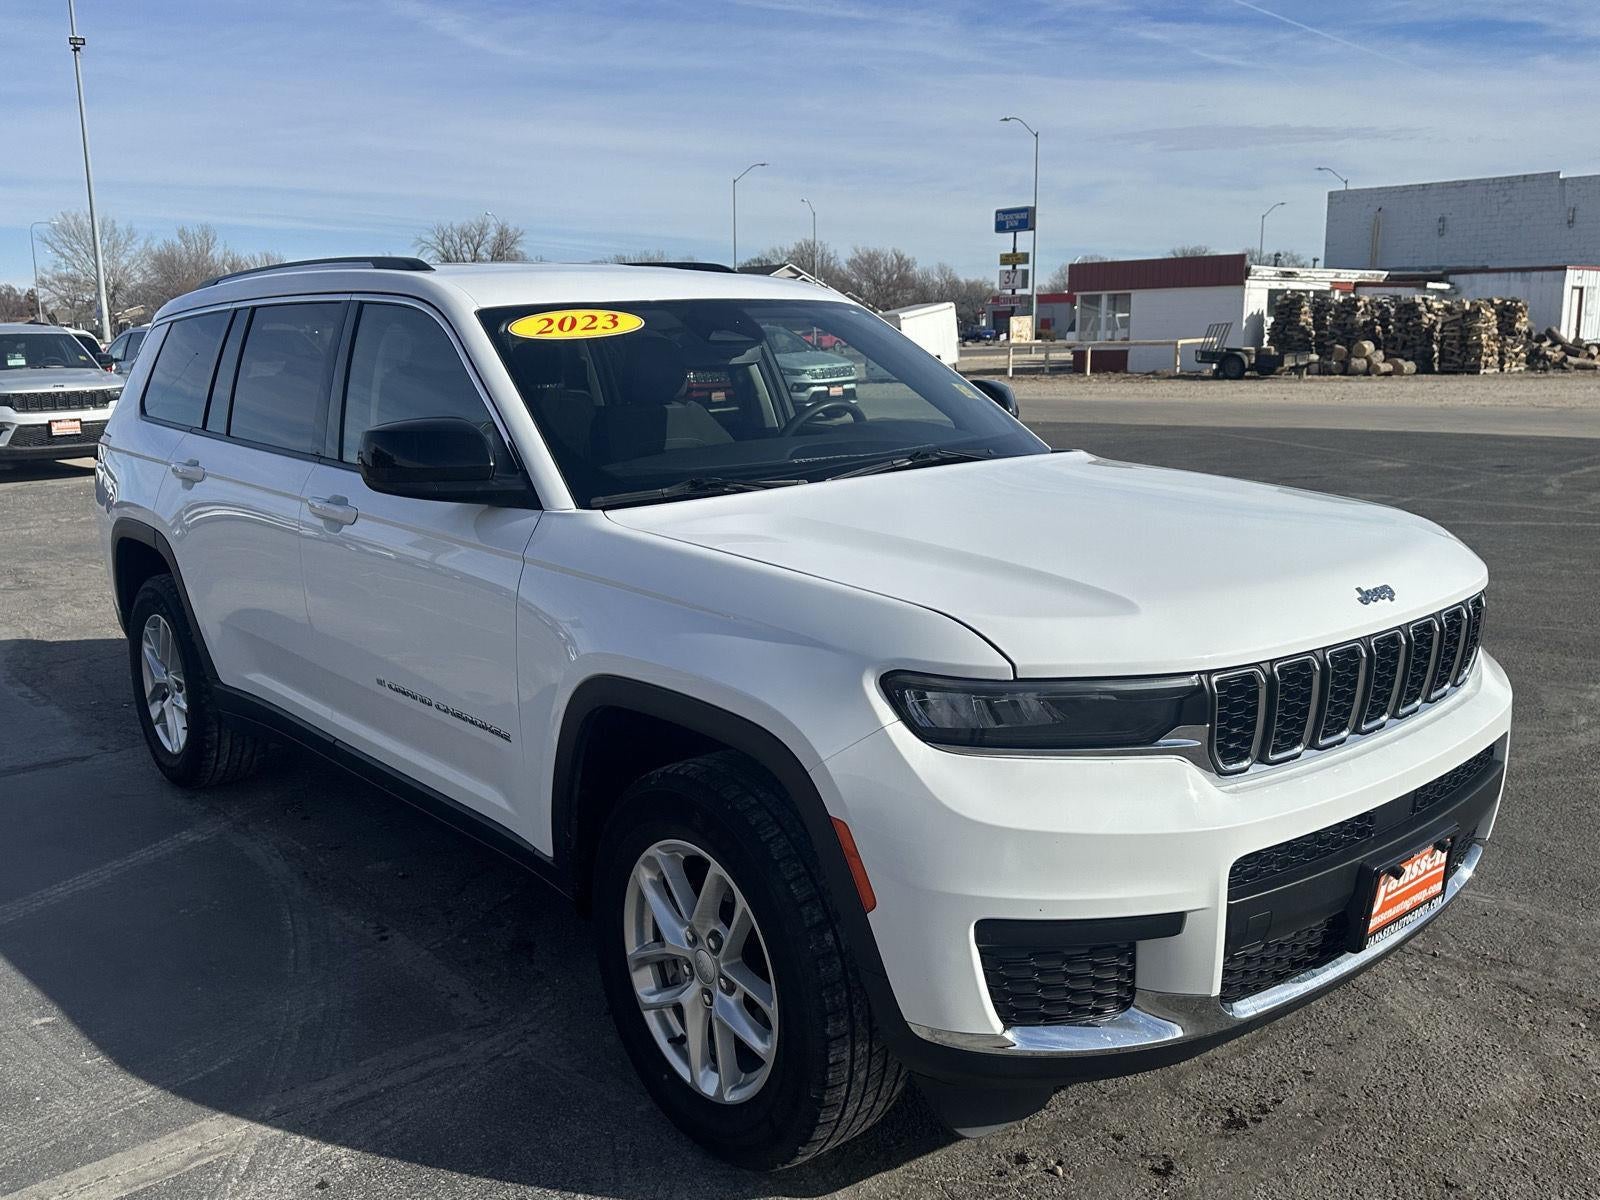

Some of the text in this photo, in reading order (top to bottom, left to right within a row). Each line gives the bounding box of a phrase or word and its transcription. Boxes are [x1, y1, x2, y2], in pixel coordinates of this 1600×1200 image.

[1004, 270, 1017, 284] 37
[536, 314, 618, 335] 2023
[1355, 584, 1395, 605] Jeep
[387, 681, 512, 743] GRAND CHEROKEE
